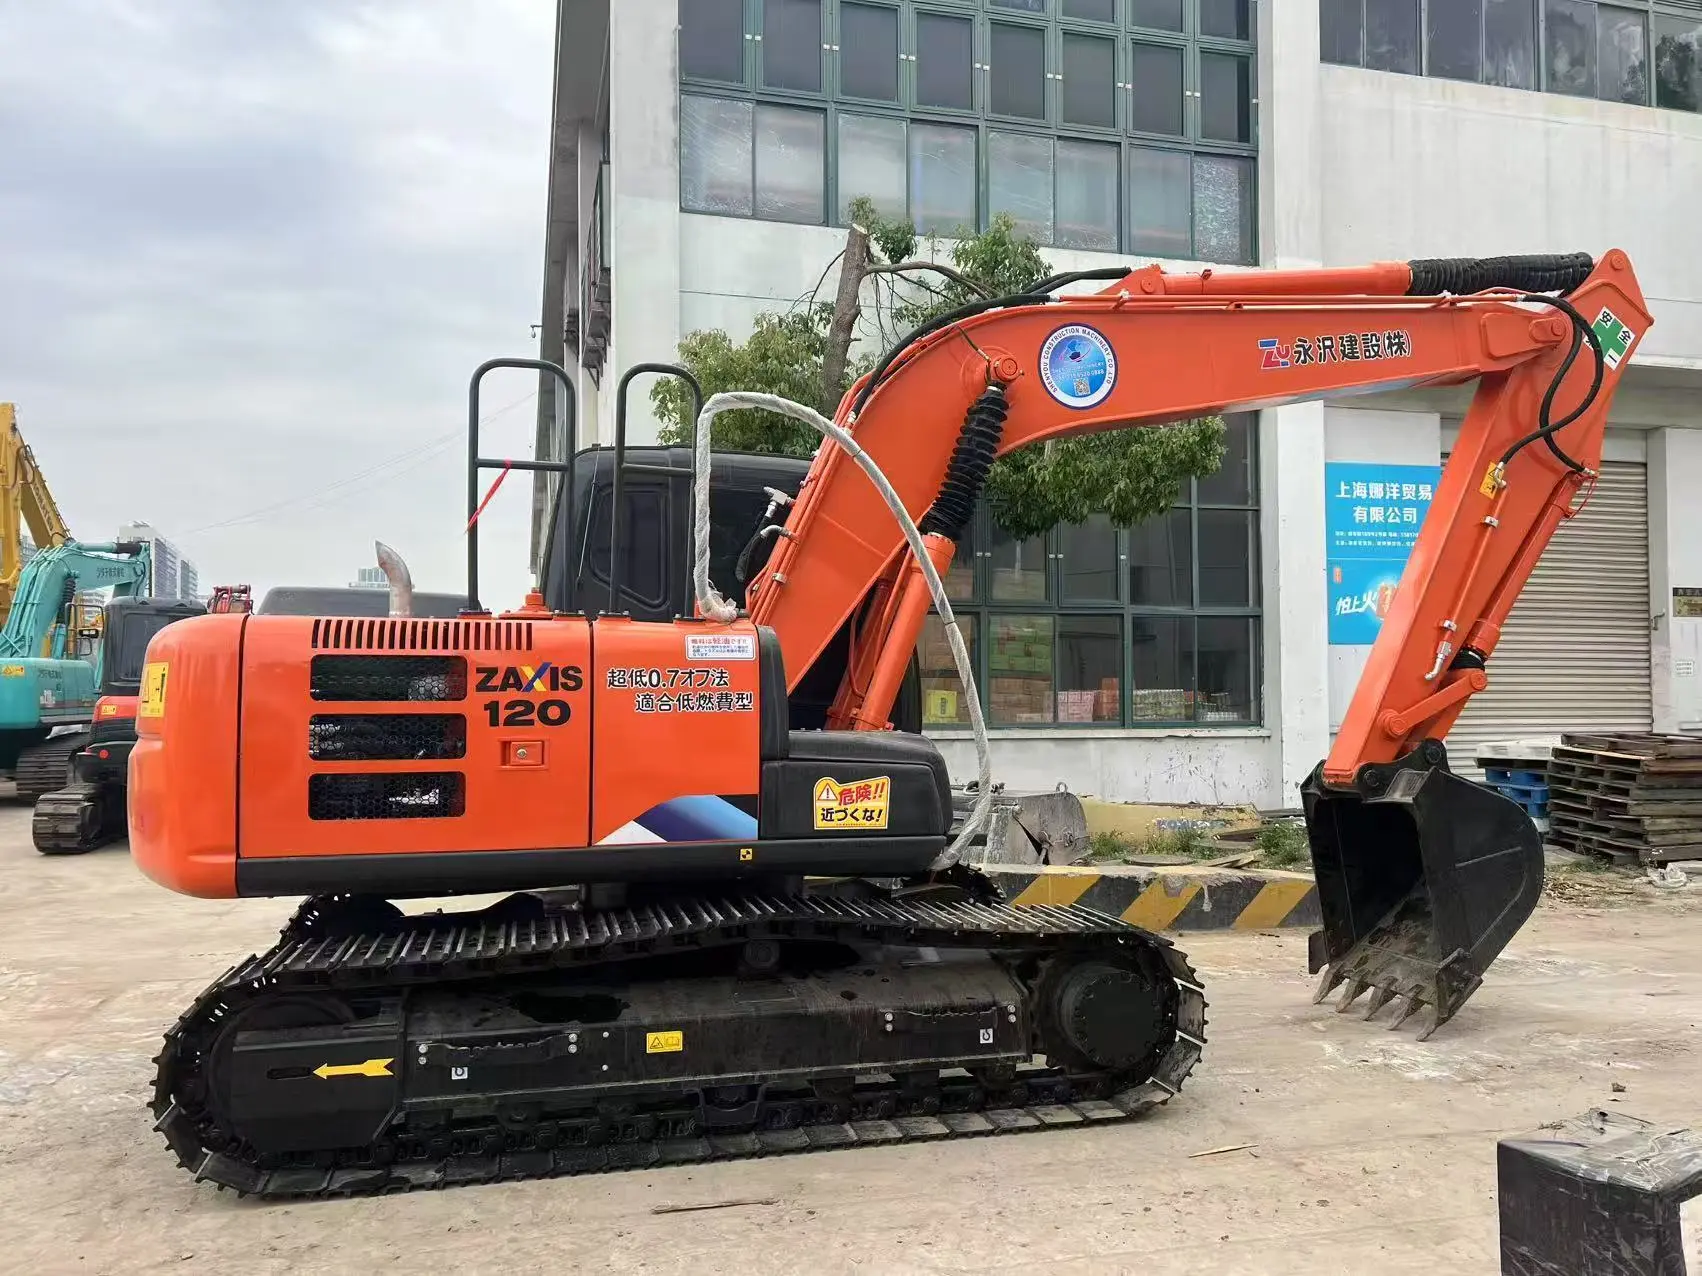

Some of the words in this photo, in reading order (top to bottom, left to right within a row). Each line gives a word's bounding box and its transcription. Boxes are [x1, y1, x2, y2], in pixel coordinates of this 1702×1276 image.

[1043, 327, 1080, 360] CONSTRUCTION
[1082, 329, 1111, 356] MACHINERY
[1293, 330, 1412, 365] 永沢建設(株)
[1335, 481, 1432, 500] 上海娜洋贸易
[1353, 505, 1417, 524] 有限公司
[475, 662, 583, 693] ZAXIS
[607, 668, 730, 689] 超低0.7オフ法
[483, 700, 571, 727] 120
[635, 692, 753, 713] 適合低燃費型
[838, 782, 886, 806] 危険!!
[820, 807, 883, 822] 近づくな!
